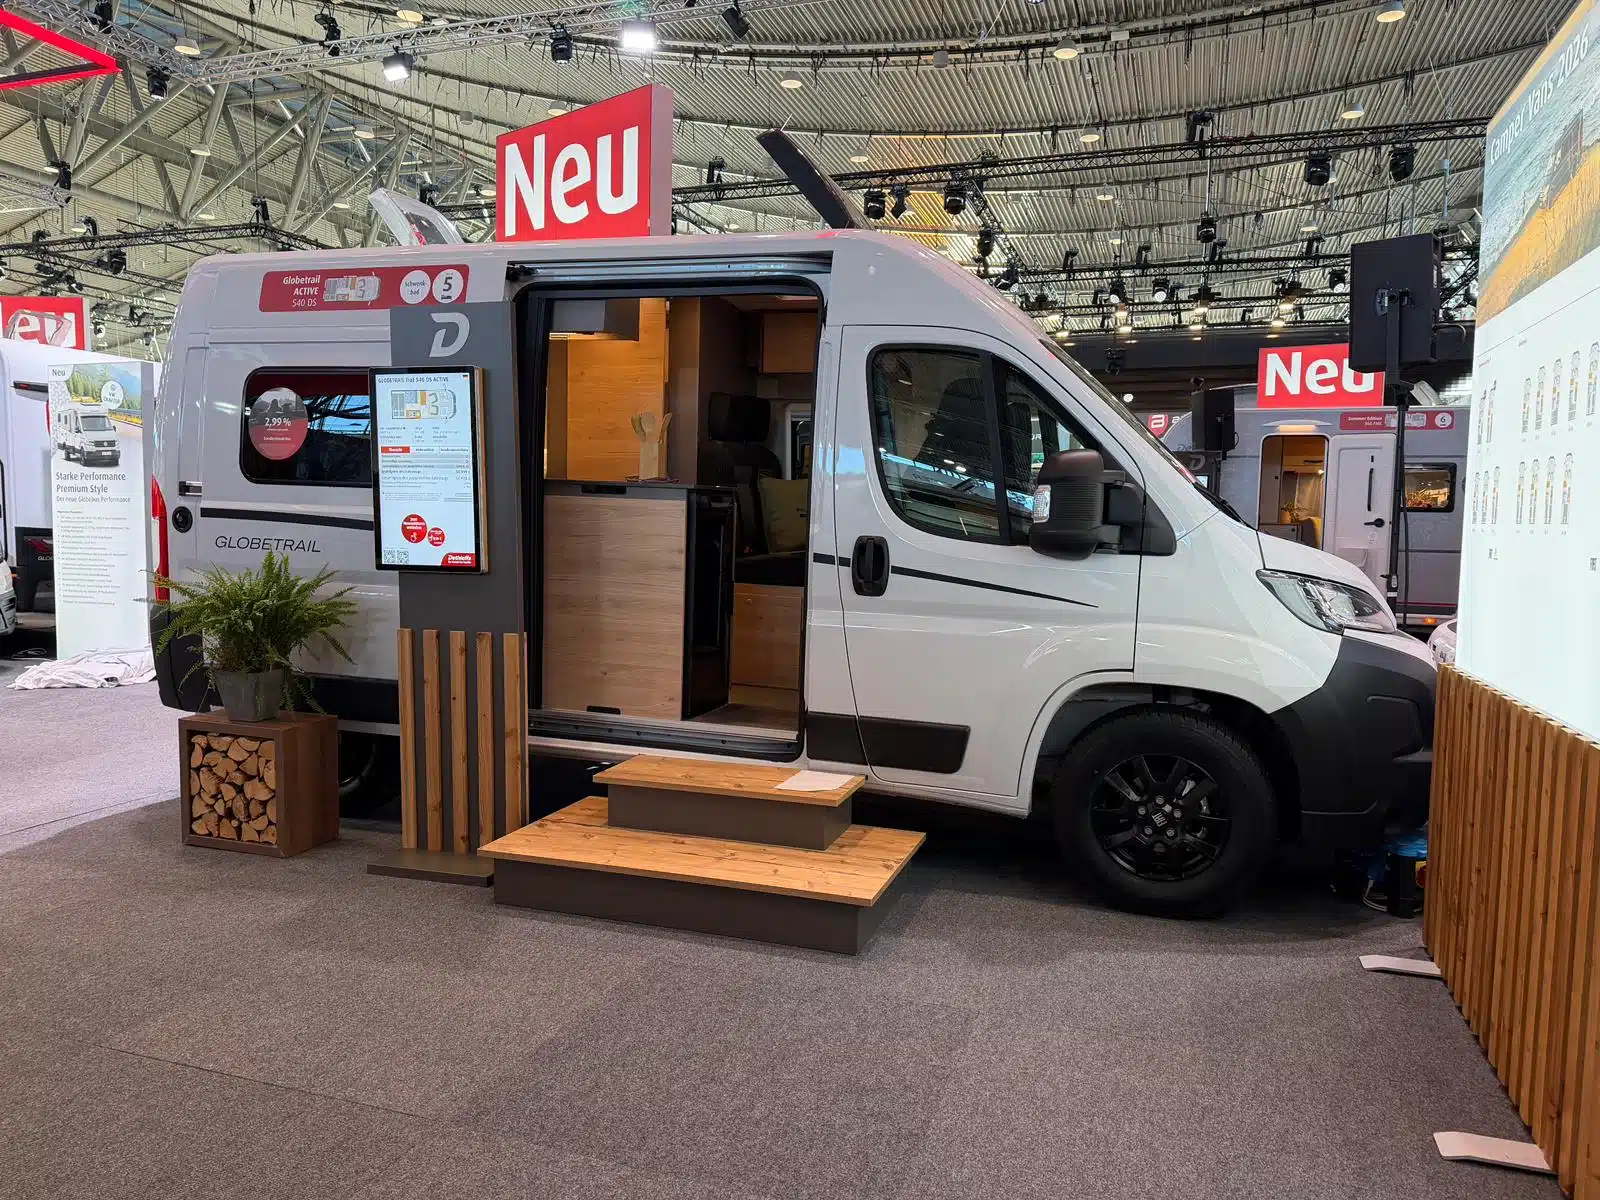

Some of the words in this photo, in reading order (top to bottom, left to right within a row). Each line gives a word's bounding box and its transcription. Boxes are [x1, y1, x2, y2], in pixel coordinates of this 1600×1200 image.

[1489, 106, 1525, 166] Camper
[1528, 71, 1554, 120] Vans
[1557, 22, 1589, 89] 2026
[504, 125, 639, 238] Neu
[283, 275, 321, 285] Globetrail
[443, 276, 453, 292] 5
[293, 287, 320, 296] ACTIVE
[292, 298, 306, 307] 540
[307, 298, 317, 307] DS
[0, 311, 77, 348] eu
[52, 368, 66, 377] Neu
[1440, 415, 1446, 423] 6
[56, 471, 79, 481] Starke
[80, 472, 126, 481] Performance
[56, 484, 89, 493] Premium
[89, 484, 109, 495] Style
[215, 535, 321, 553] GLOBETRAIL
